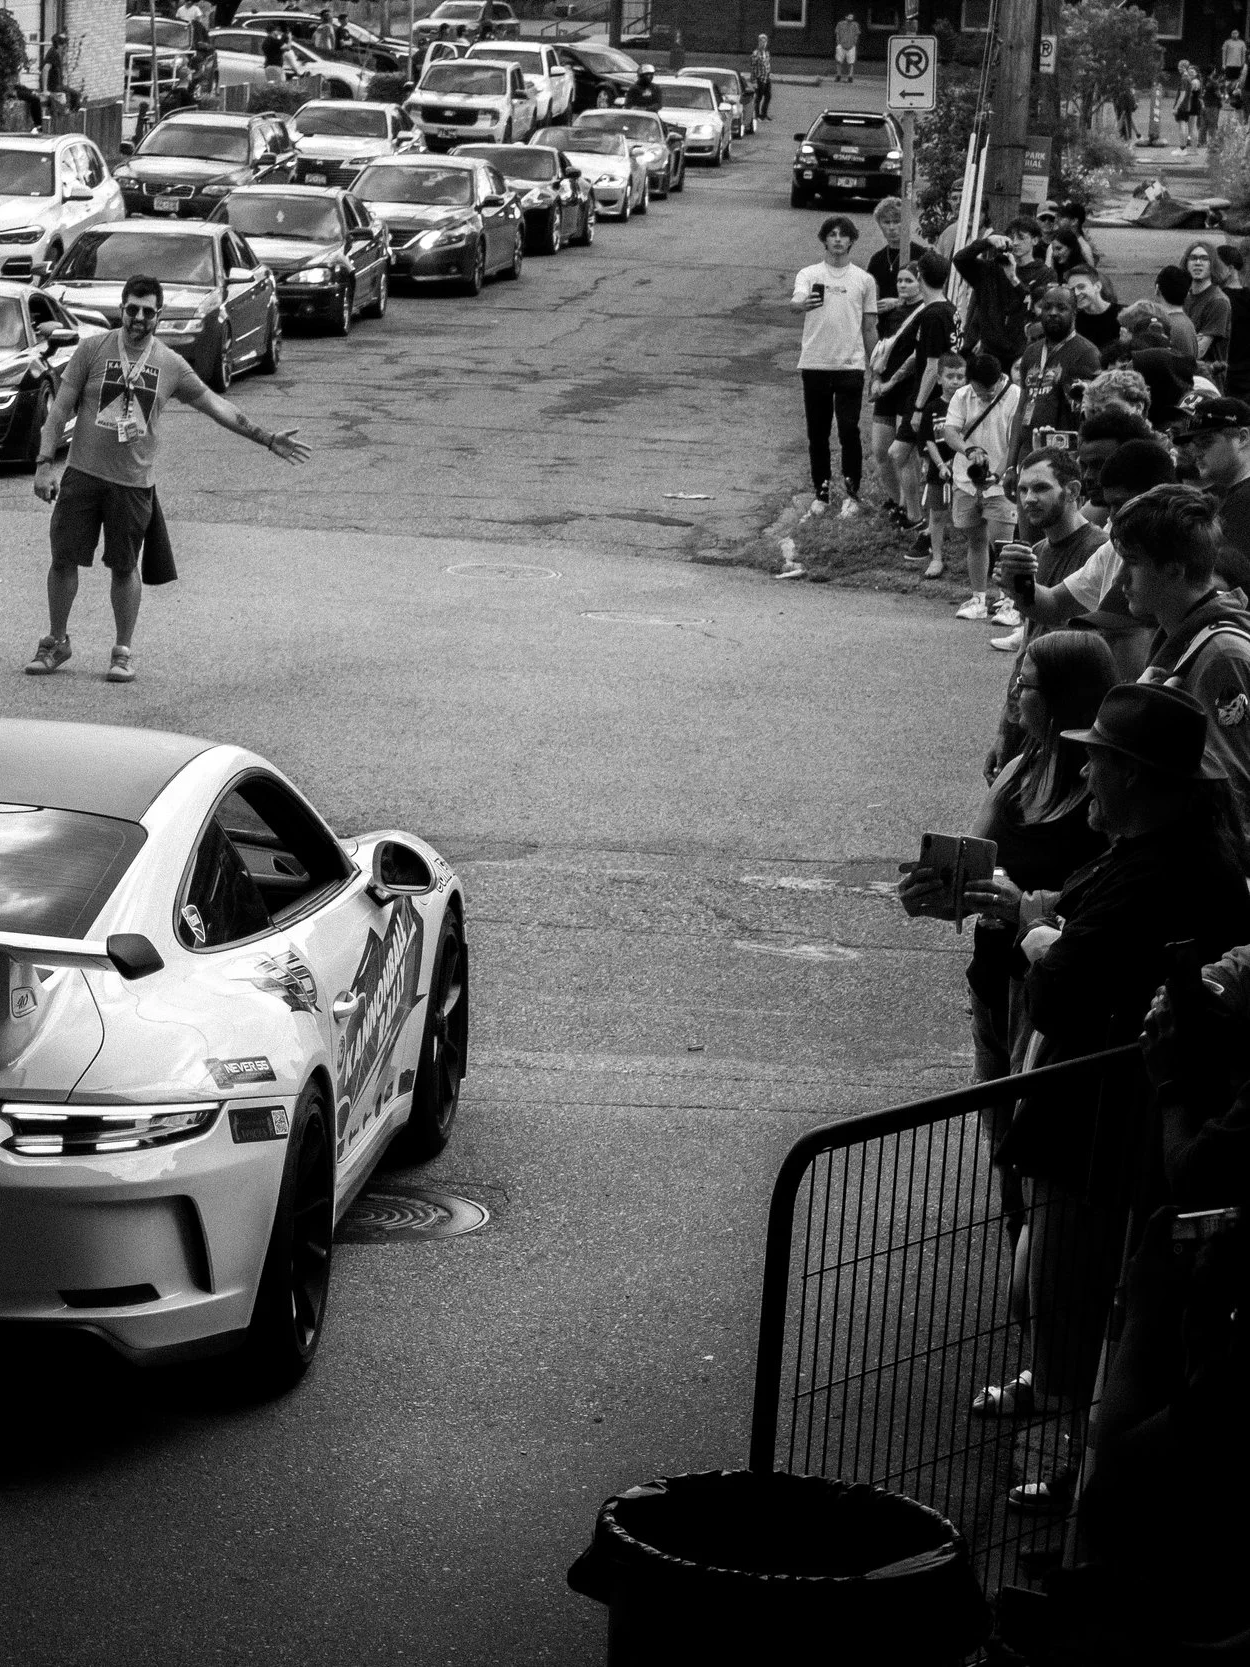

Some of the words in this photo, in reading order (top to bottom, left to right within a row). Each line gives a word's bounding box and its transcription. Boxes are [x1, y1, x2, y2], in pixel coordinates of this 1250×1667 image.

[344, 912, 407, 1088] KANNONBALL
[376, 955, 406, 1052] RALLY
[224, 1061, 257, 1074] NEVER
[255, 1060, 270, 1071] 55
